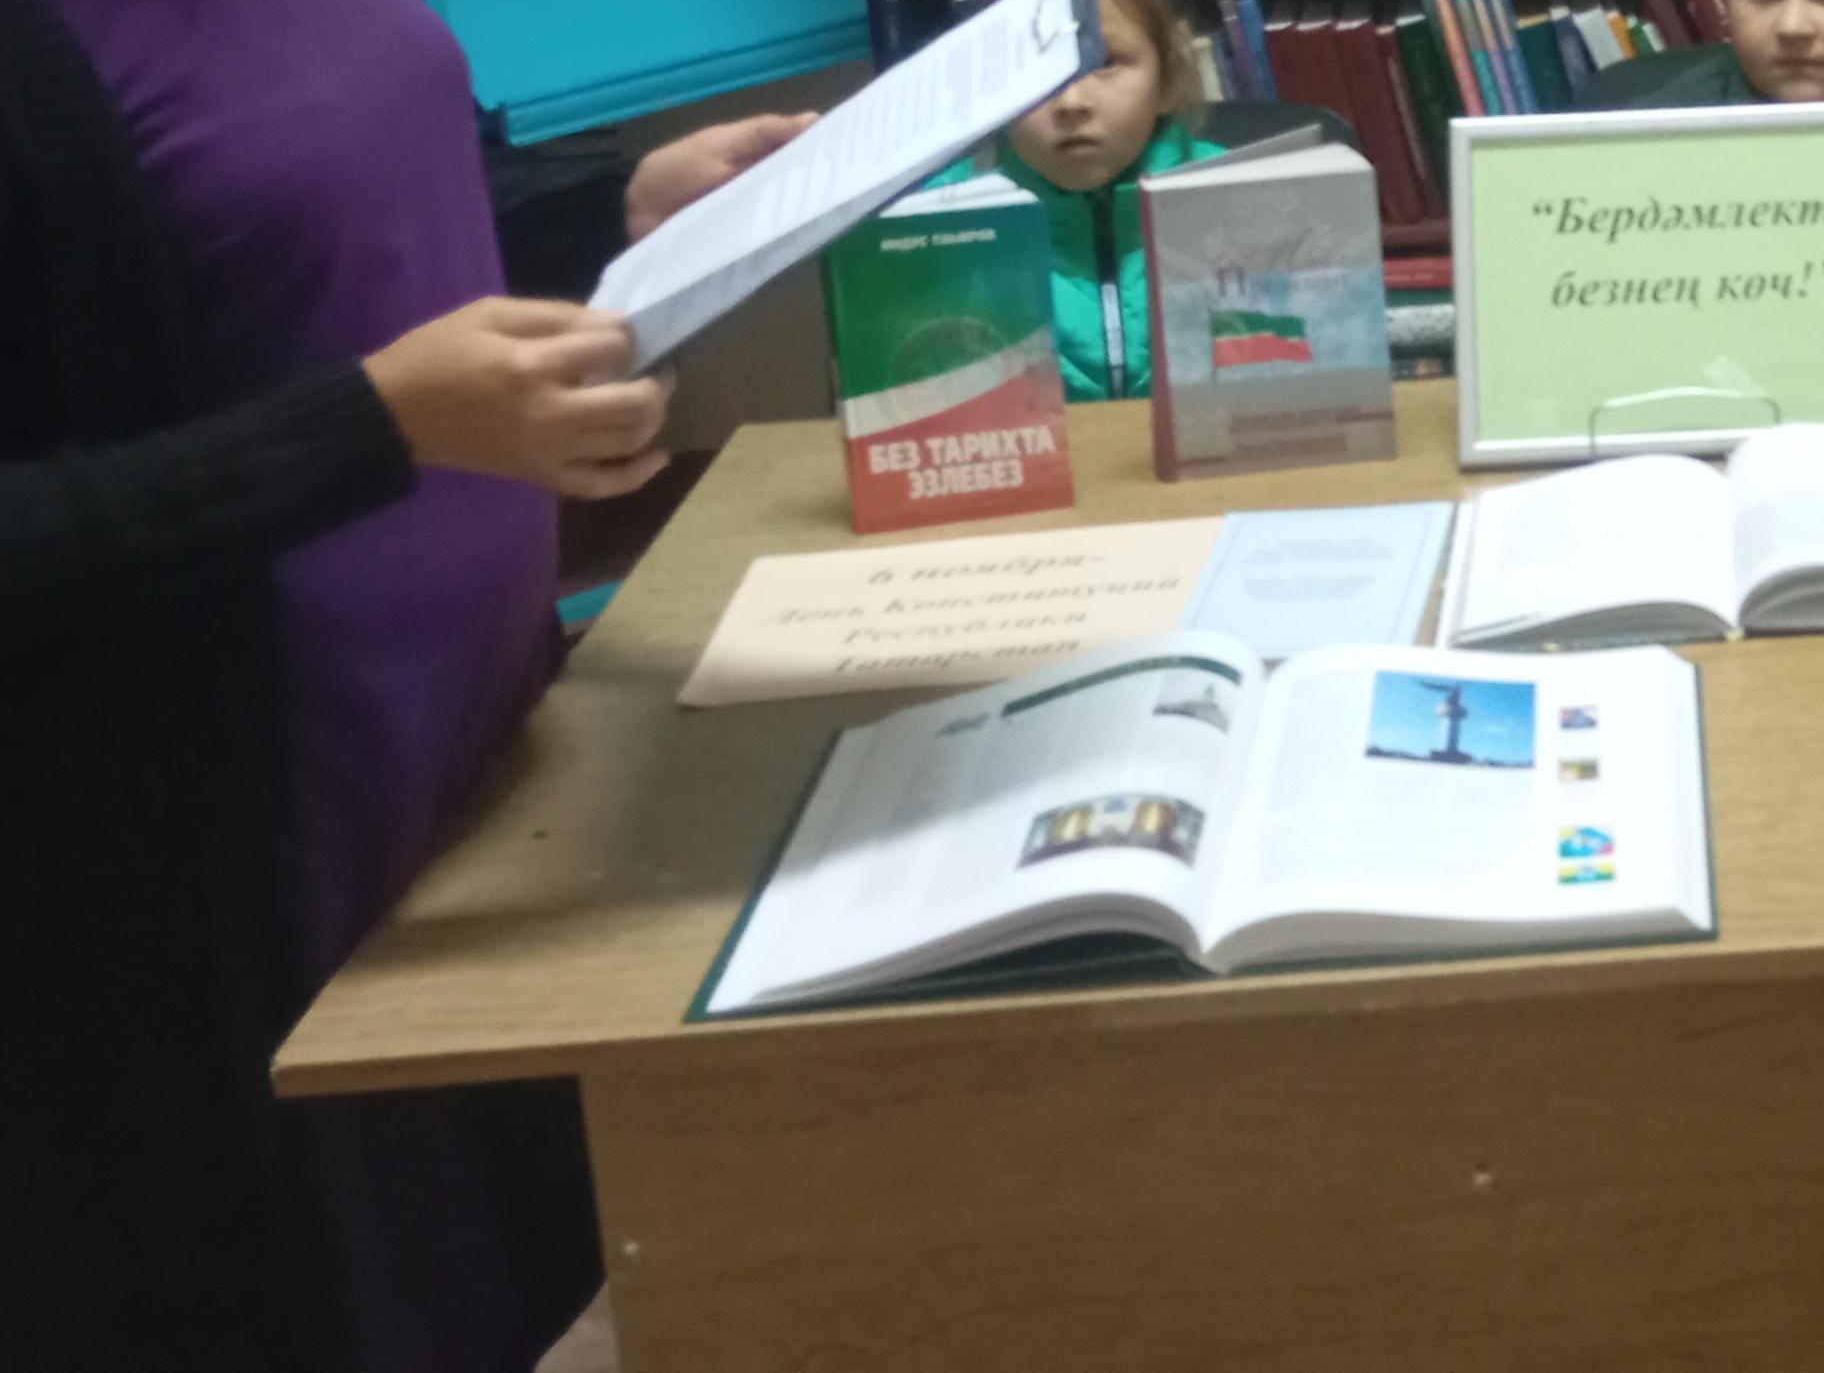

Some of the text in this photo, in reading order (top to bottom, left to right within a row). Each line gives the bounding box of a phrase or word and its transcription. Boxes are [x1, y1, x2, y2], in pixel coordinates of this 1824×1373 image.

[1551, 270, 1702, 310] безнең
[868, 425, 1057, 473] БЕЗ ТАРИХТА
